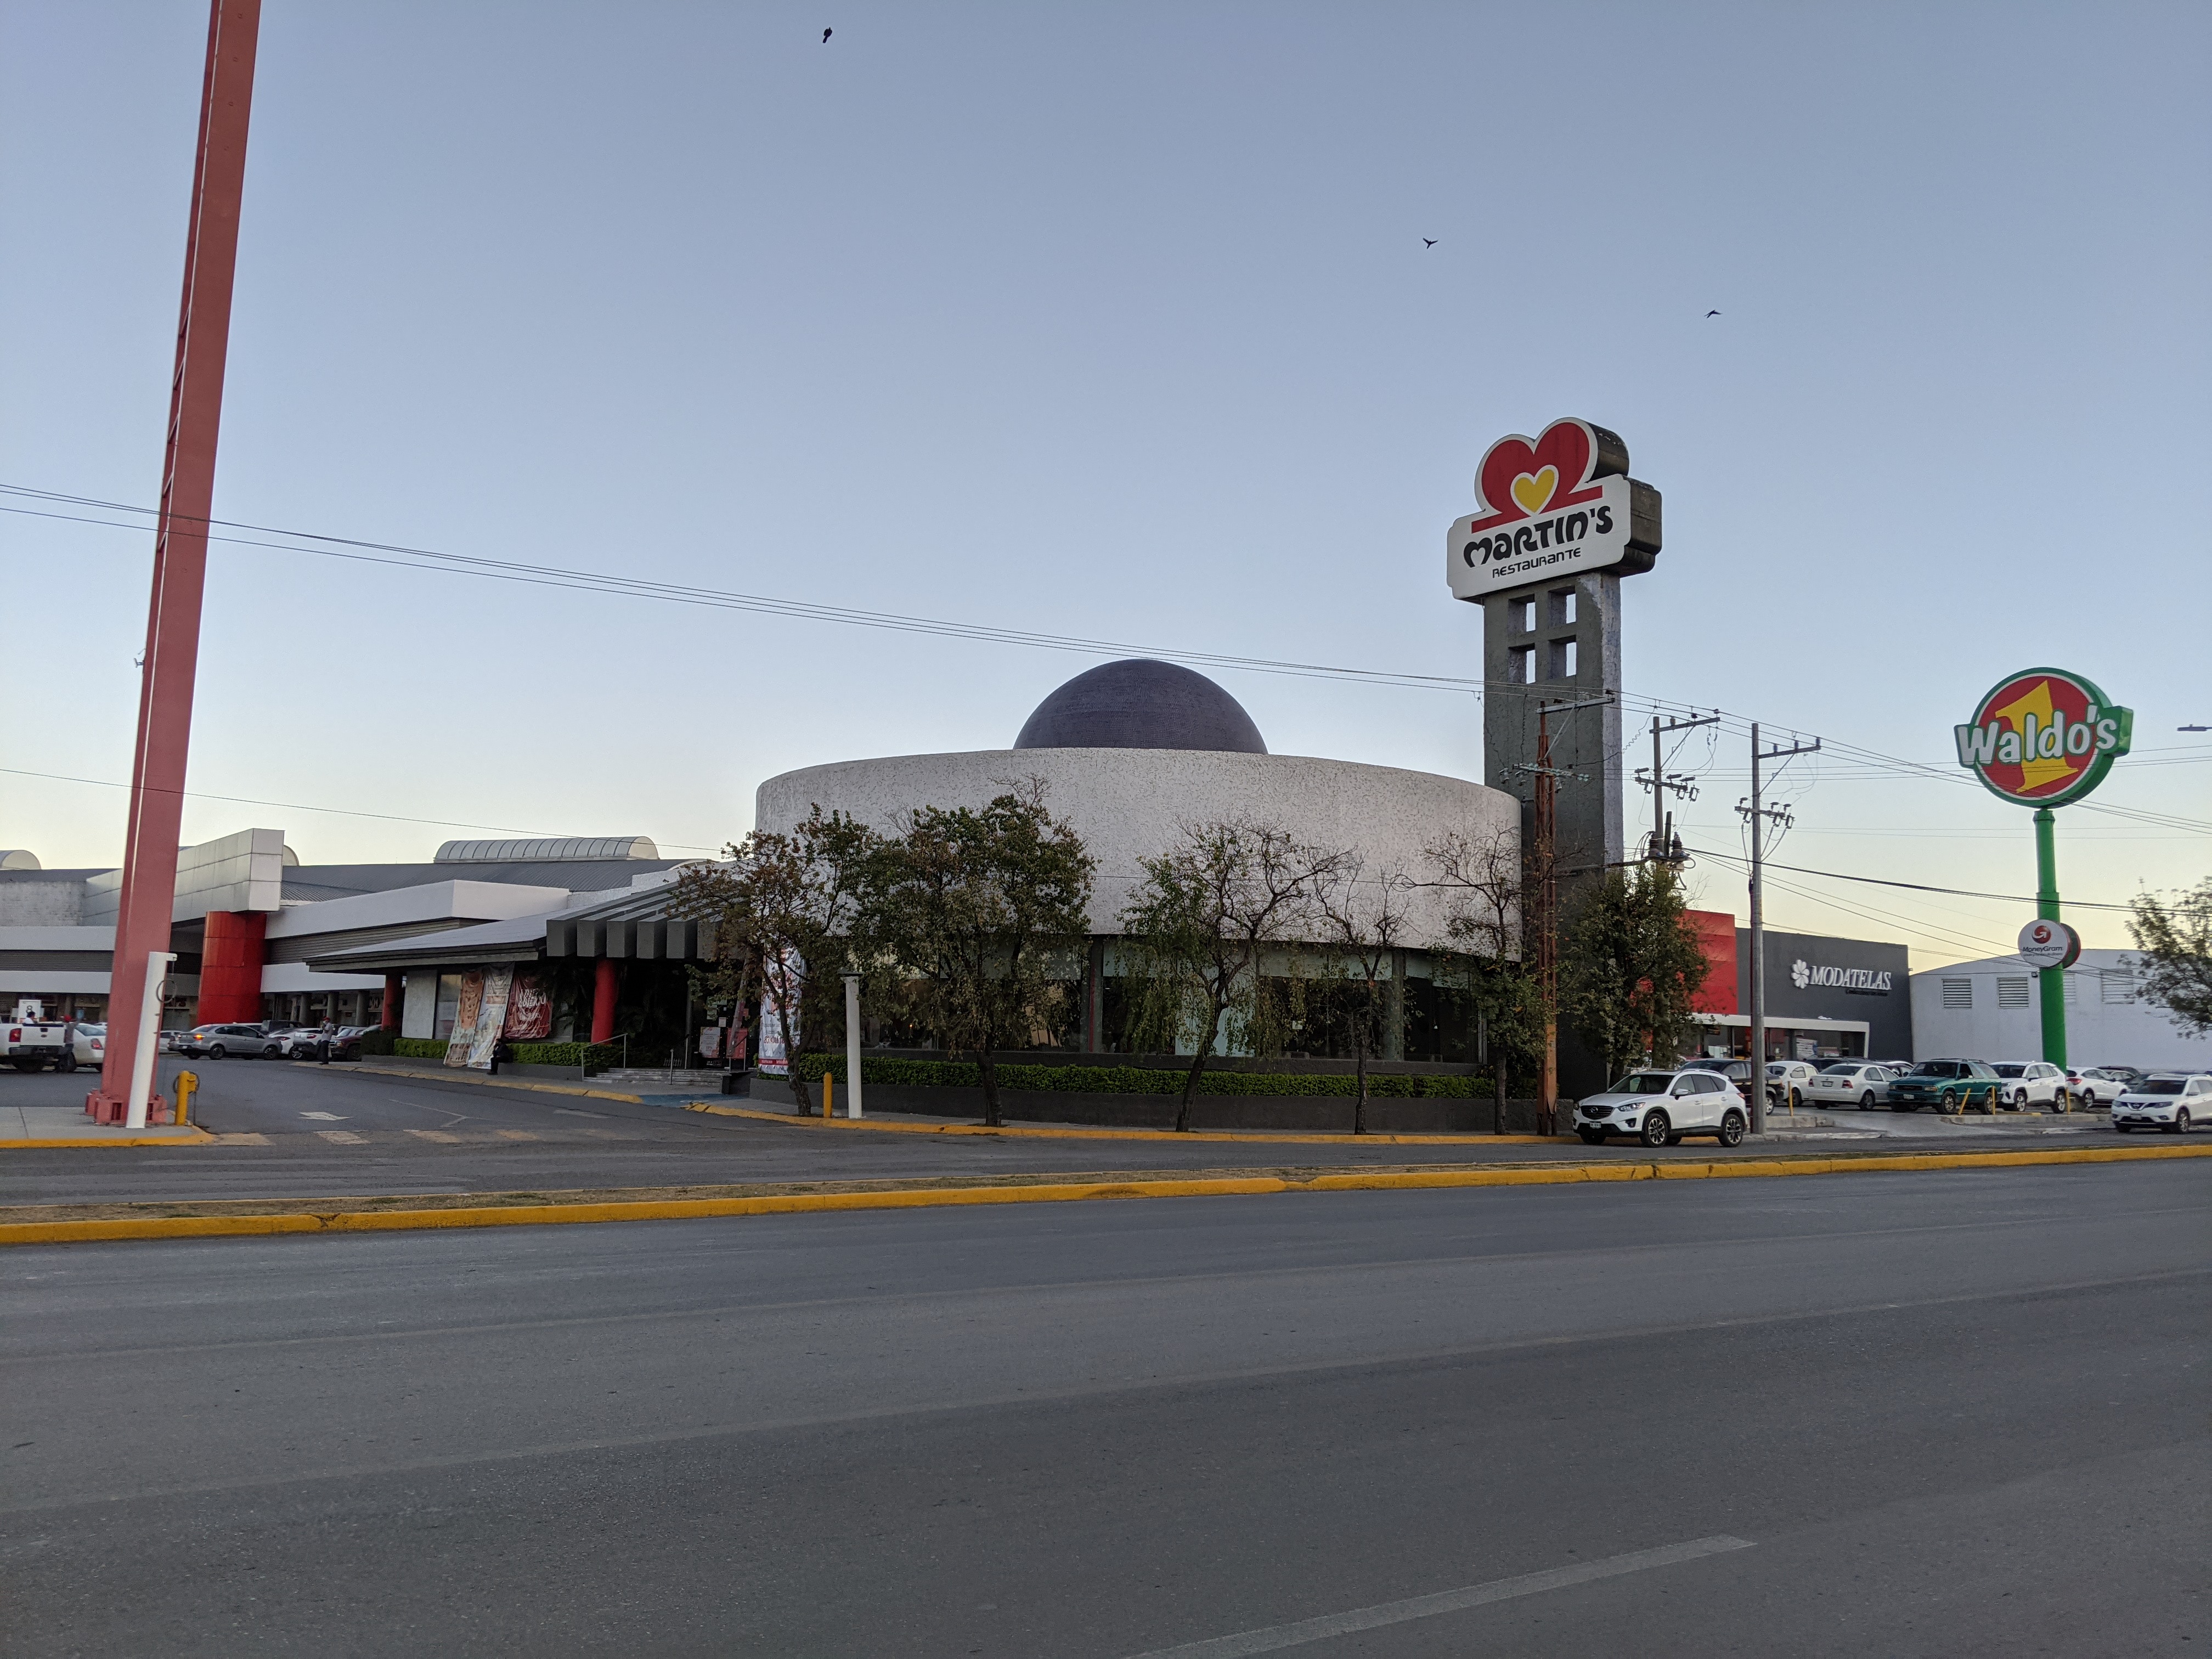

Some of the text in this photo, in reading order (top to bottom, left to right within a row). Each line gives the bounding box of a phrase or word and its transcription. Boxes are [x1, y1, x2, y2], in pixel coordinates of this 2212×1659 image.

[1492, 547, 1581, 579] RESTAURANTE
[1957, 704, 2118, 765] Waldo's
[1810, 966, 1892, 990] MODATELAS
